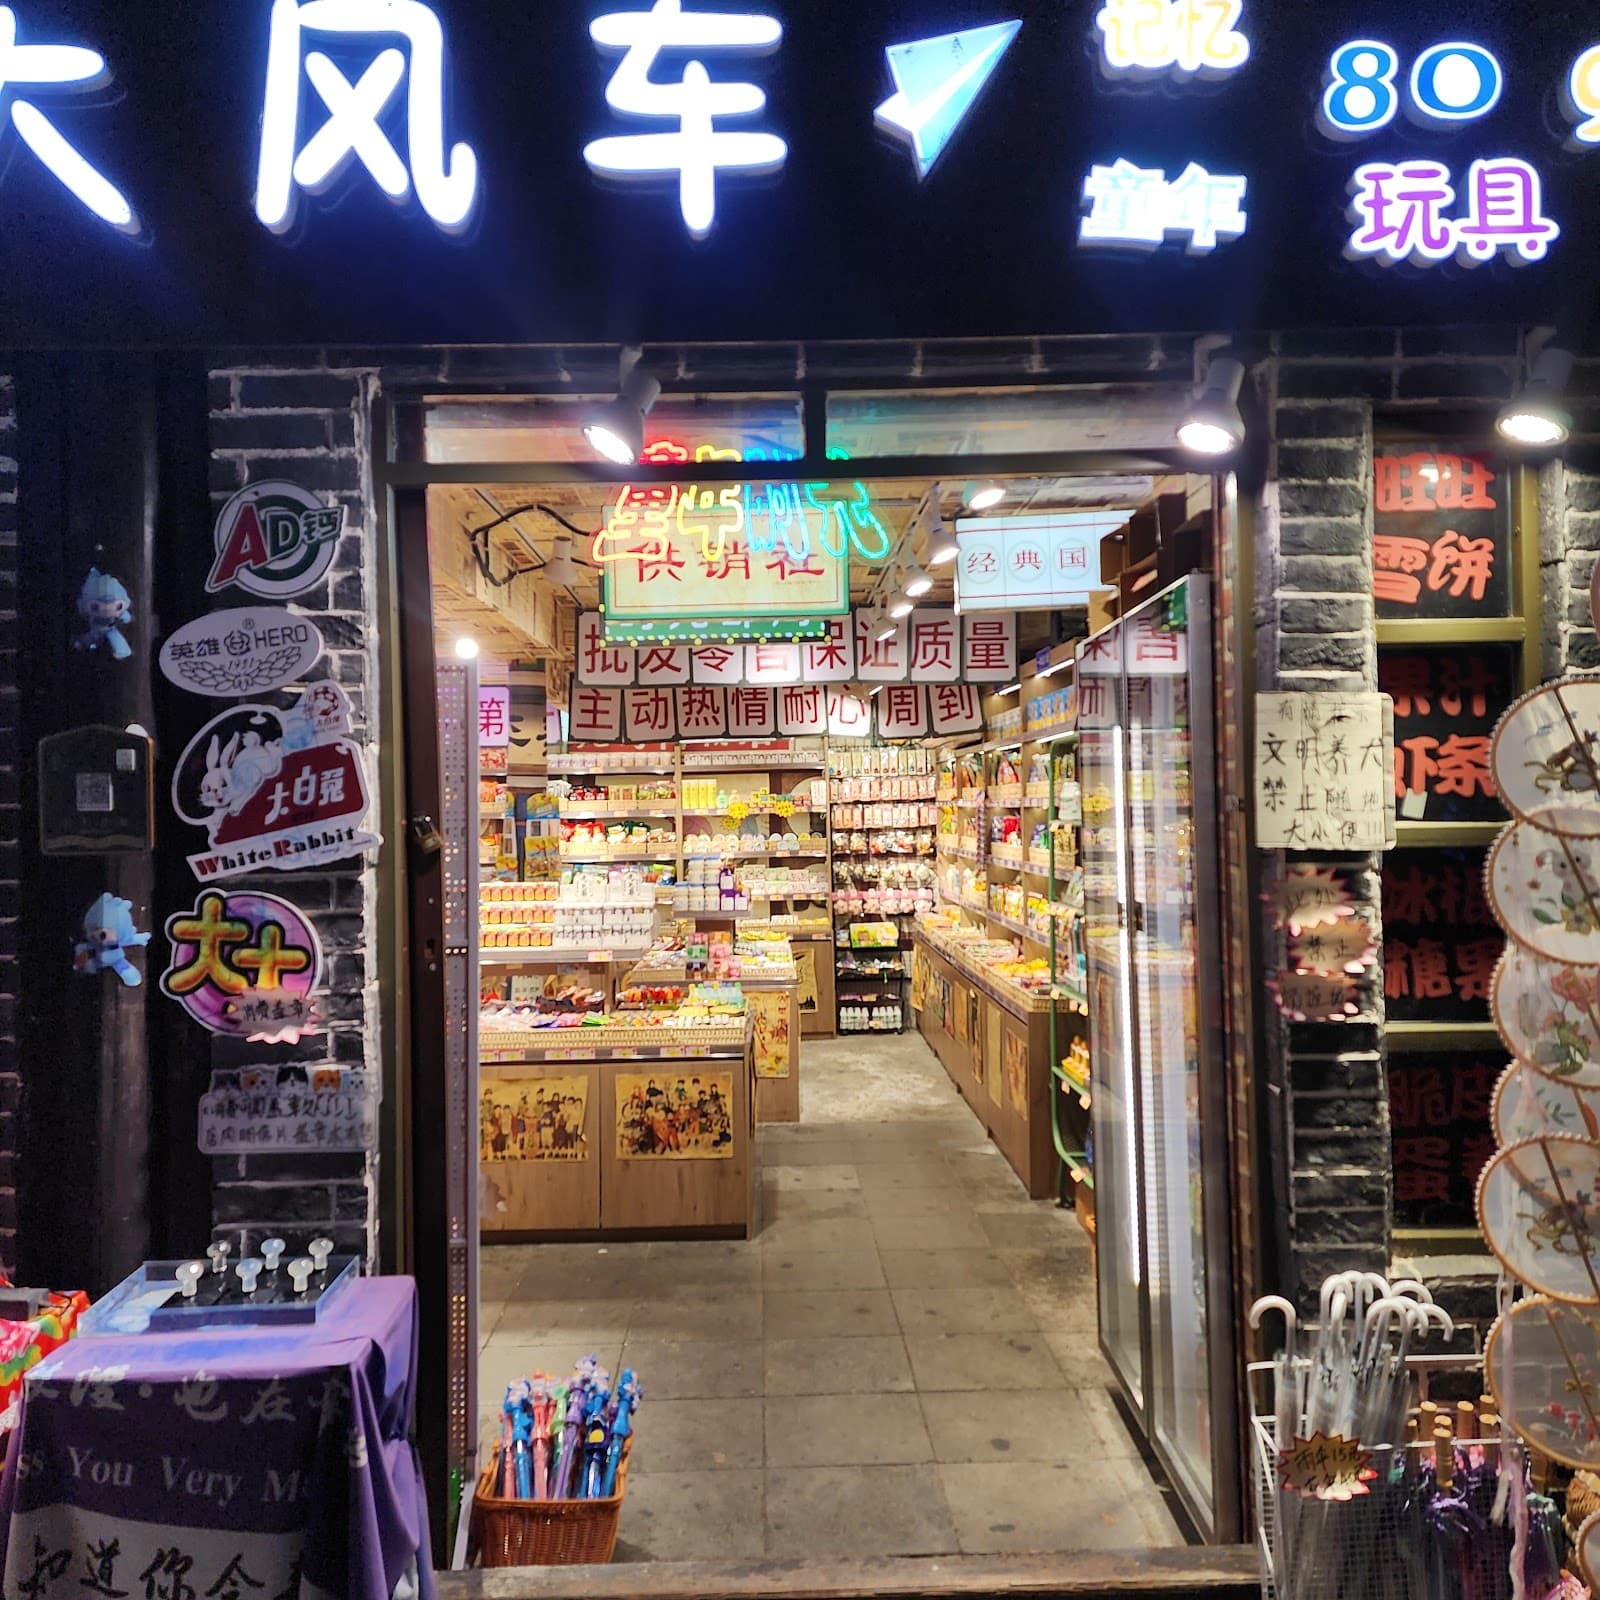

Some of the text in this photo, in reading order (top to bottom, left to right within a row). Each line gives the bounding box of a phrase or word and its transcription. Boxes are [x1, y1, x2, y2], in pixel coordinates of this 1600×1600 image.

[1097, 0, 1249, 70] 记忆
[1081, 157, 1248, 247] 童年
[1350, 157, 1559, 260] 玩具
[1375, 451, 1497, 512] 旺旺
[626, 539, 825, 584] 供销社
[1374, 529, 1495, 604] 雪饼
[169, 624, 309, 661] 英雄 HERO
[575, 683, 977, 732] 主动热情耐心周到
[263, 764, 345, 825] 大白兔
[194, 825, 356, 876] White Rabbit
[66, 1446, 133, 1486] You
[161, 1456, 241, 1506] Very
